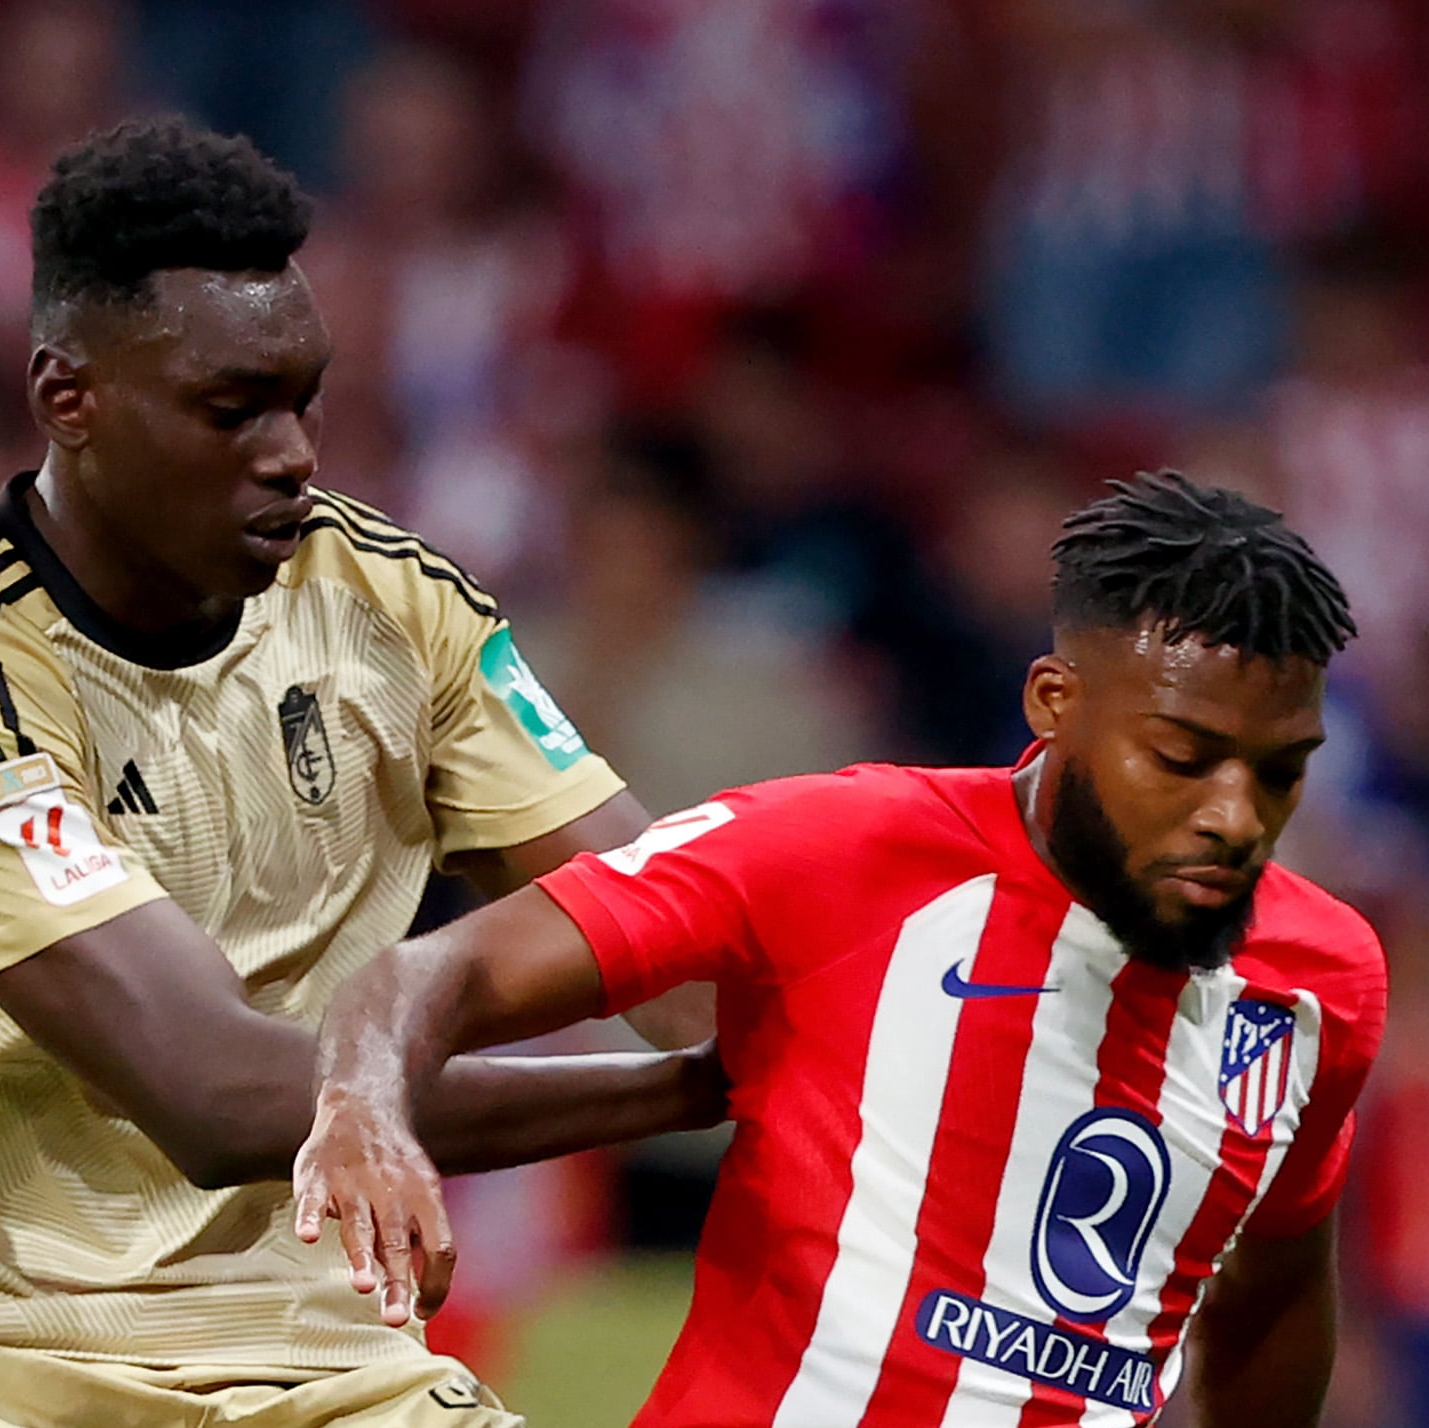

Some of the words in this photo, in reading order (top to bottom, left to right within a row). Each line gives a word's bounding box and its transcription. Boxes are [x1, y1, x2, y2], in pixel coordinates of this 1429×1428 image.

[51, 853, 112, 890] LALIGA
[926, 1295, 1110, 1392] RIYADH
[1105, 1357, 1153, 1408] AIR
